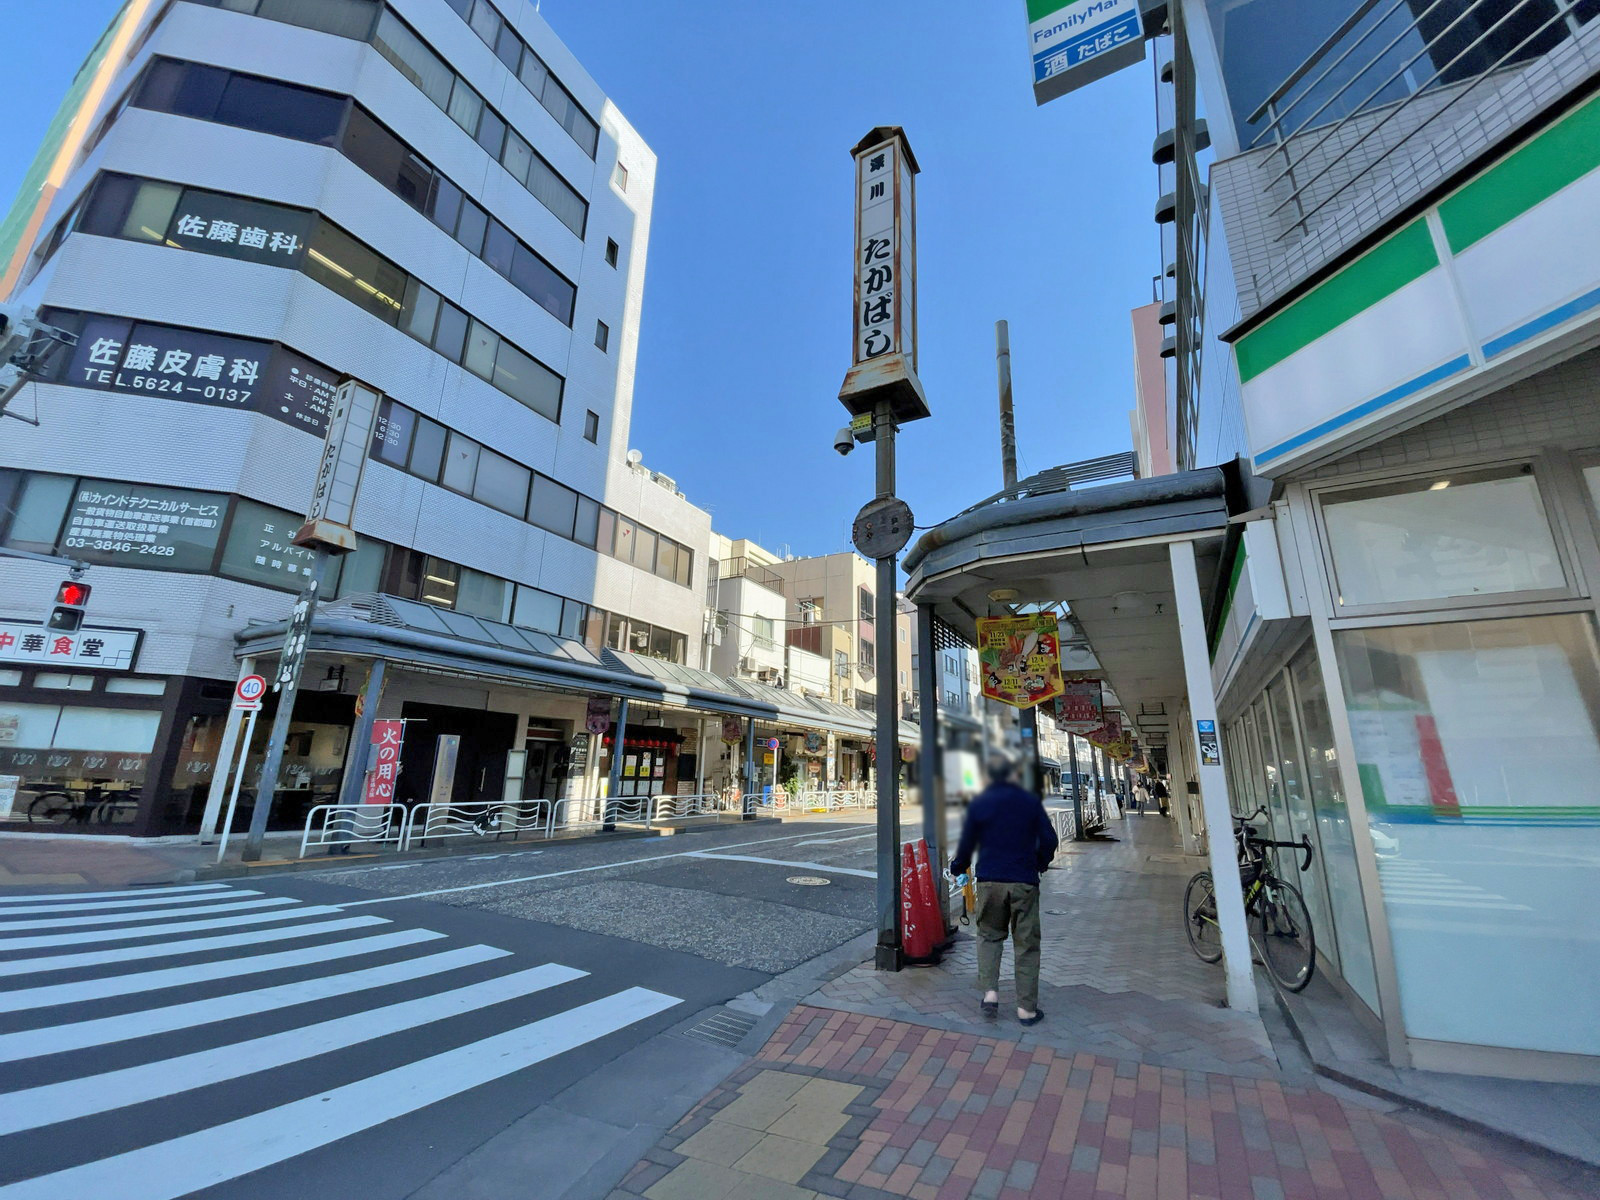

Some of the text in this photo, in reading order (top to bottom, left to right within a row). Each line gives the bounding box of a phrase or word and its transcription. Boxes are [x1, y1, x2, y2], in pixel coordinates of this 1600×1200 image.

[1044, 26, 1130, 76] 酒 たばこ
[177, 214, 298, 255] 佐藤歯科
[863, 238, 893, 357] たかばし
[89, 337, 259, 386] 佐藤皮膚科
[378, 416, 401, 431] 12:30
[380, 425, 400, 439] 6:30
[375, 431, 398, 446] 12:30
[65, 537, 175, 557] 03-3846-2428
[260, 539, 315, 560] アルバイト
[0, 631, 105, 658] 中華食堂
[243, 682, 260, 694] 40
[376, 727, 398, 797] 火の用心
